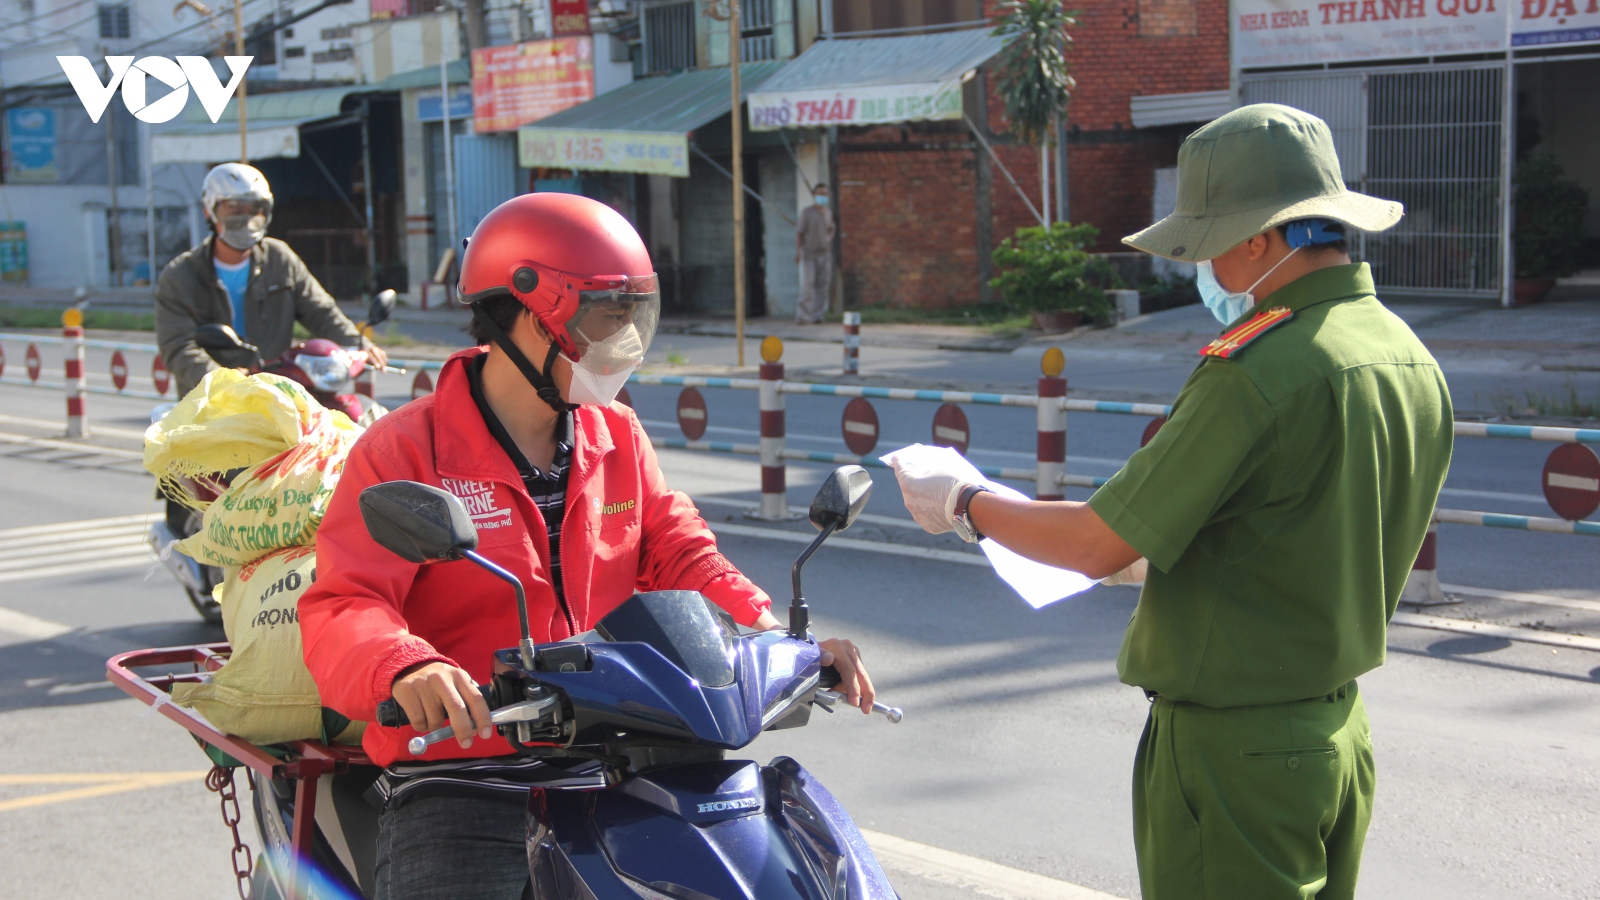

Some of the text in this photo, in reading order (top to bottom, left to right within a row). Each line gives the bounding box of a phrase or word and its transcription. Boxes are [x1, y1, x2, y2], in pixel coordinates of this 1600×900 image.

[1239, 14, 1268, 31] NHA
[1271, 10, 1309, 29] KHOA
[1319, 0, 1426, 25] THANH
[442, 478, 495, 495] STREET
